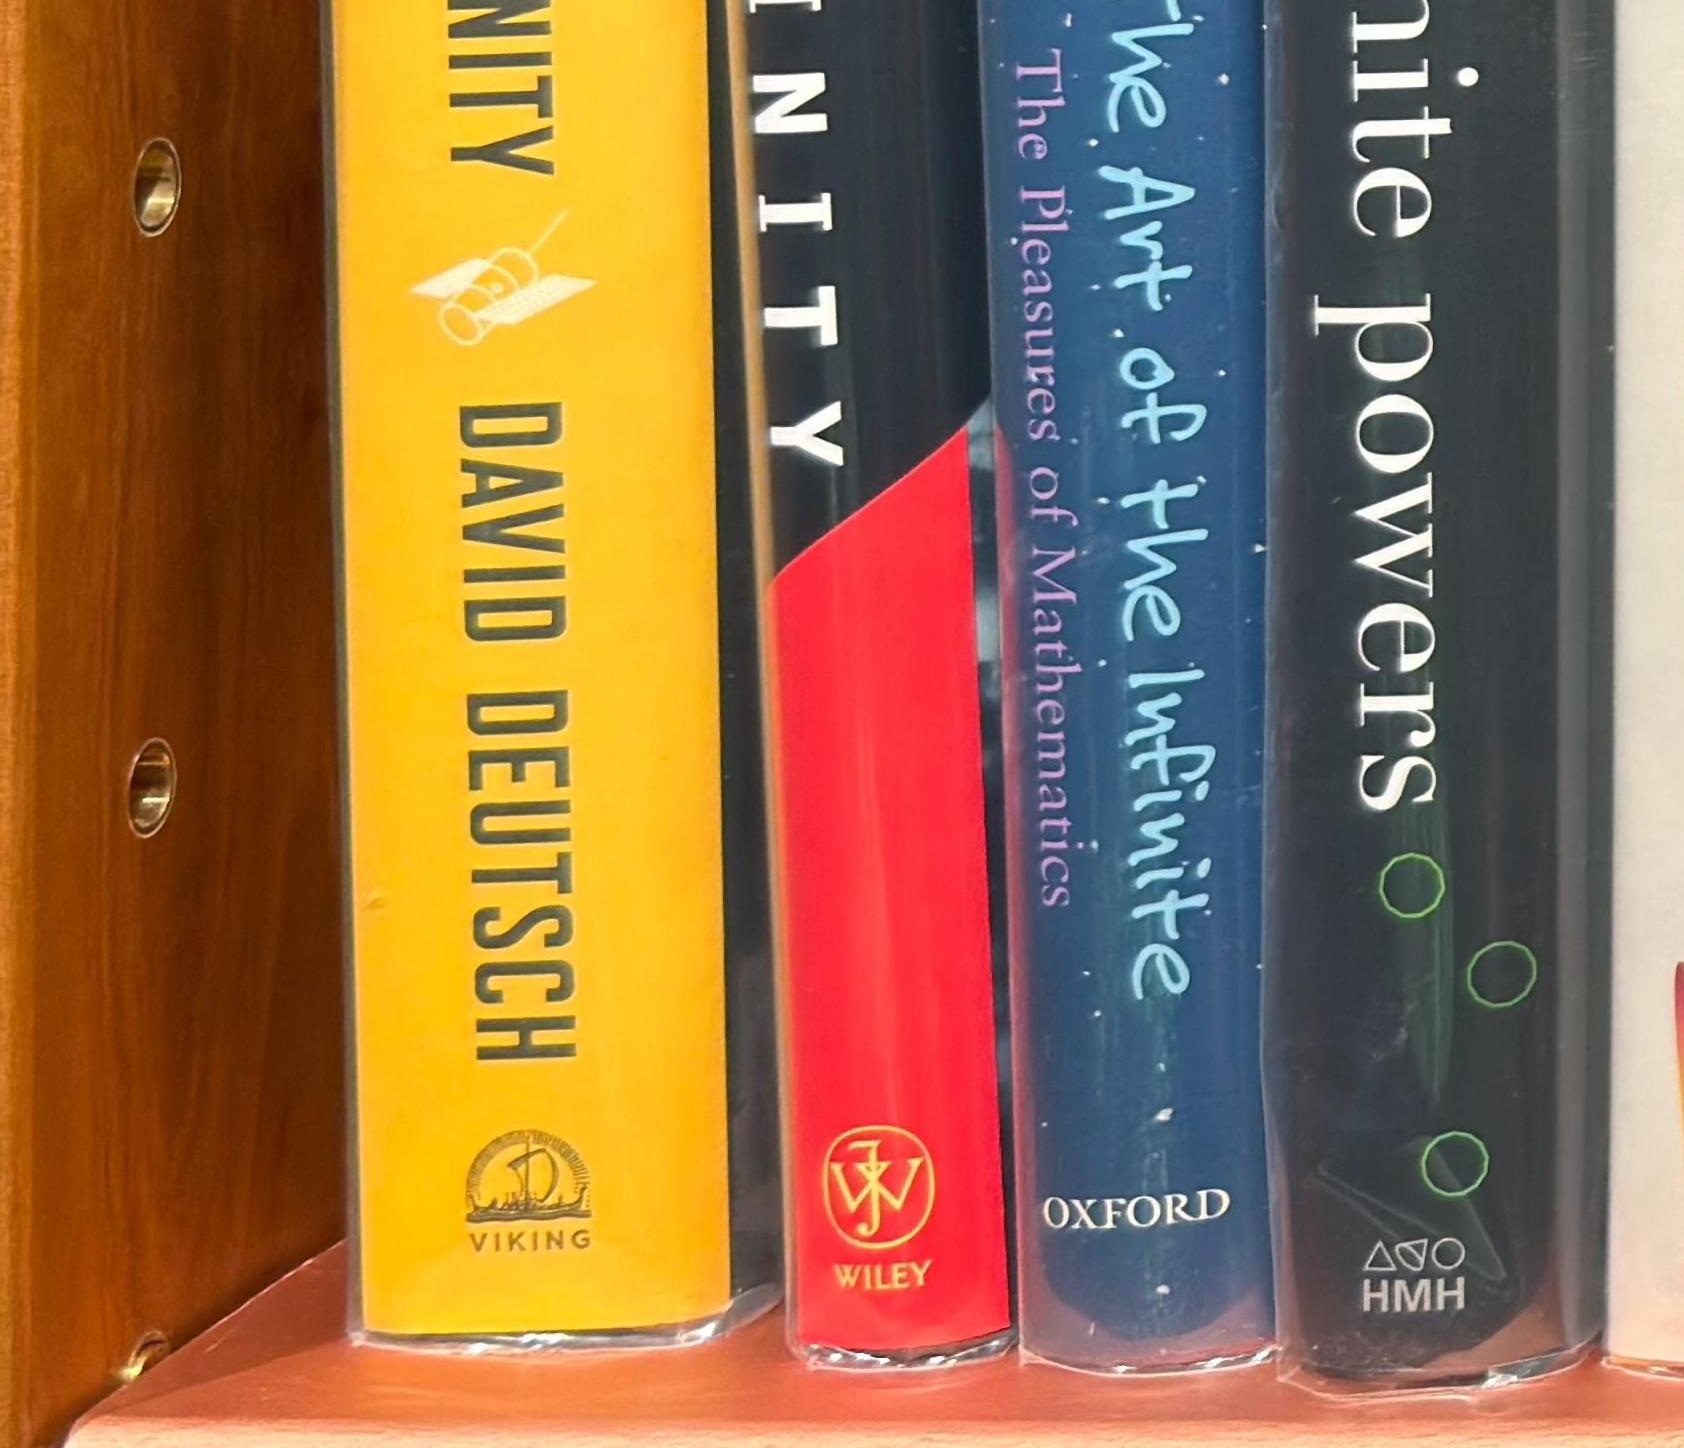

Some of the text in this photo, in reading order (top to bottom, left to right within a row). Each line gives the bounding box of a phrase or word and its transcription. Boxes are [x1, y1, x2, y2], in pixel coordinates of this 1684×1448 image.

[1103, 164, 1195, 312] Art
[1119, 348, 1206, 444] of
[1011, 48, 1083, 906] The Pleasures of Mathematics
[1120, 476, 1208, 641] the
[1313, 293, 1436, 811] powers
[460, 403, 576, 1060] DAVID DEUTSCH
[1124, 670, 1215, 1000] Infinite
[469, 1229, 590, 1252] VIKING
[835, 1260, 930, 1290] WILEY
[1043, 1189, 1230, 1229] OXFORD
[1363, 1277, 1464, 1312] HMH
